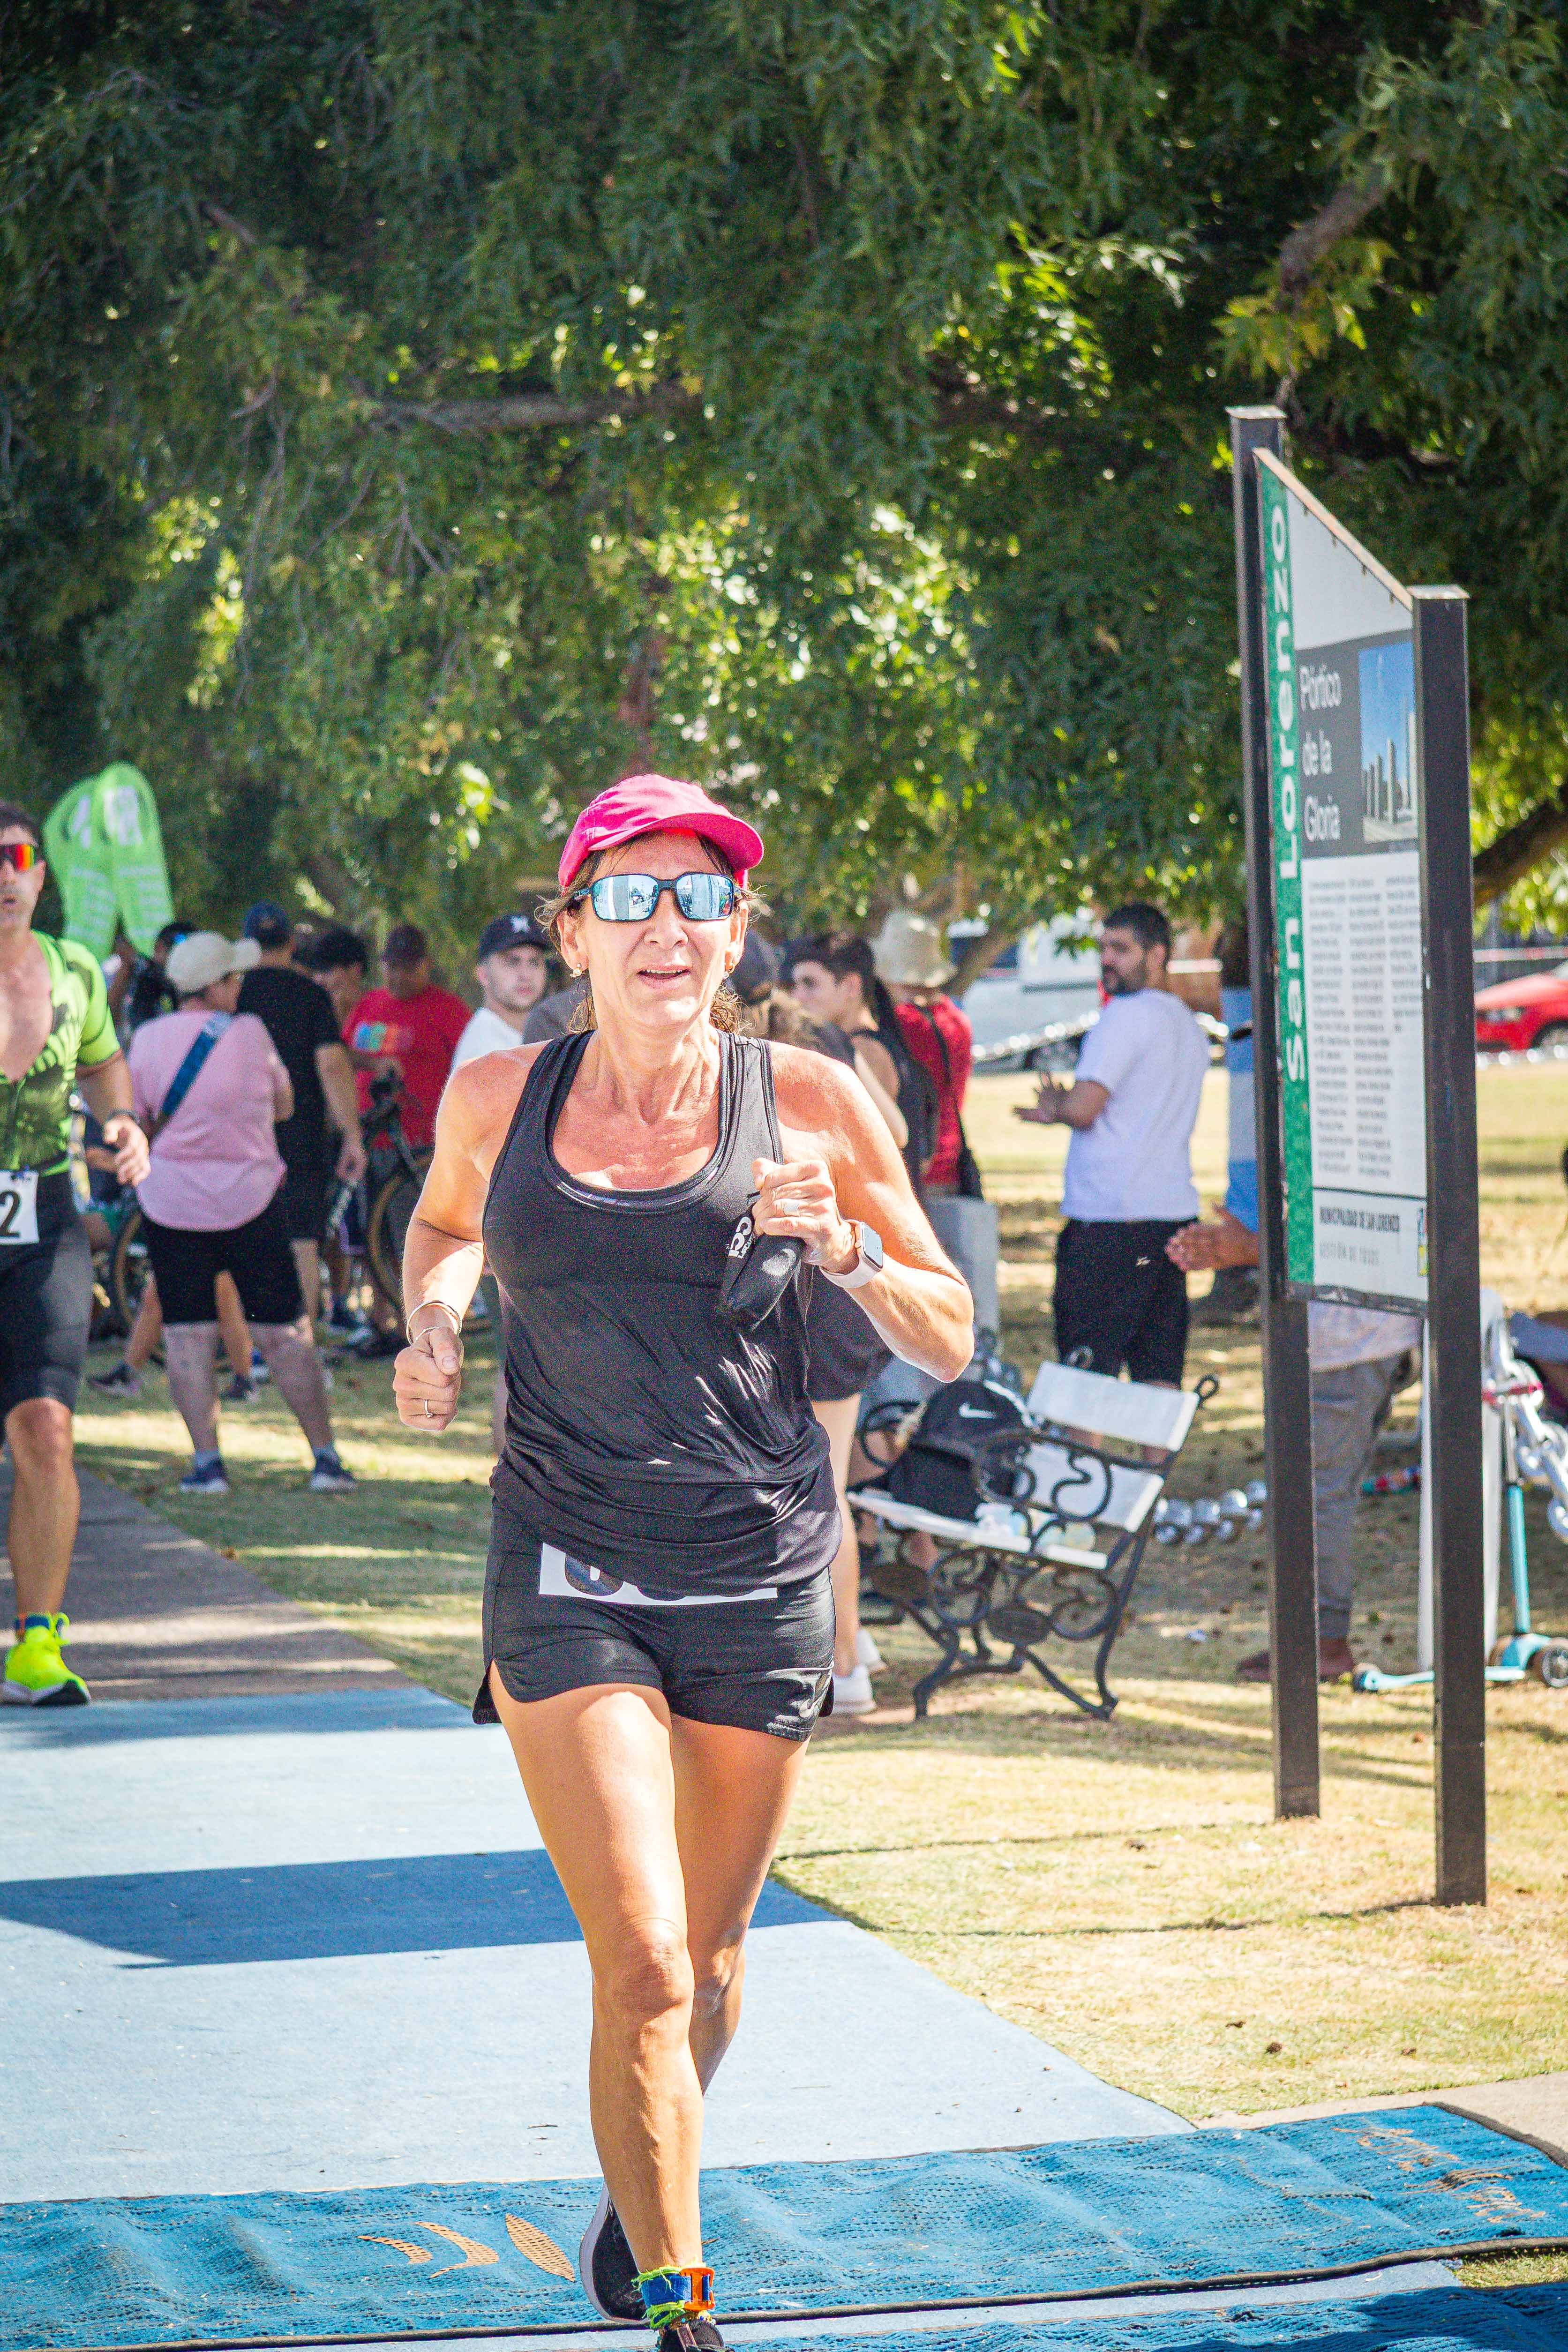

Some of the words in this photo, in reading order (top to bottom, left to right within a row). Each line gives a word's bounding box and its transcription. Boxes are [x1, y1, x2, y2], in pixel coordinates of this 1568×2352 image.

[1271, 506, 1298, 878] Lorenzo
[1303, 731, 1318, 776] de
[1319, 728, 1333, 775] la
[1284, 918, 1306, 1082] San
